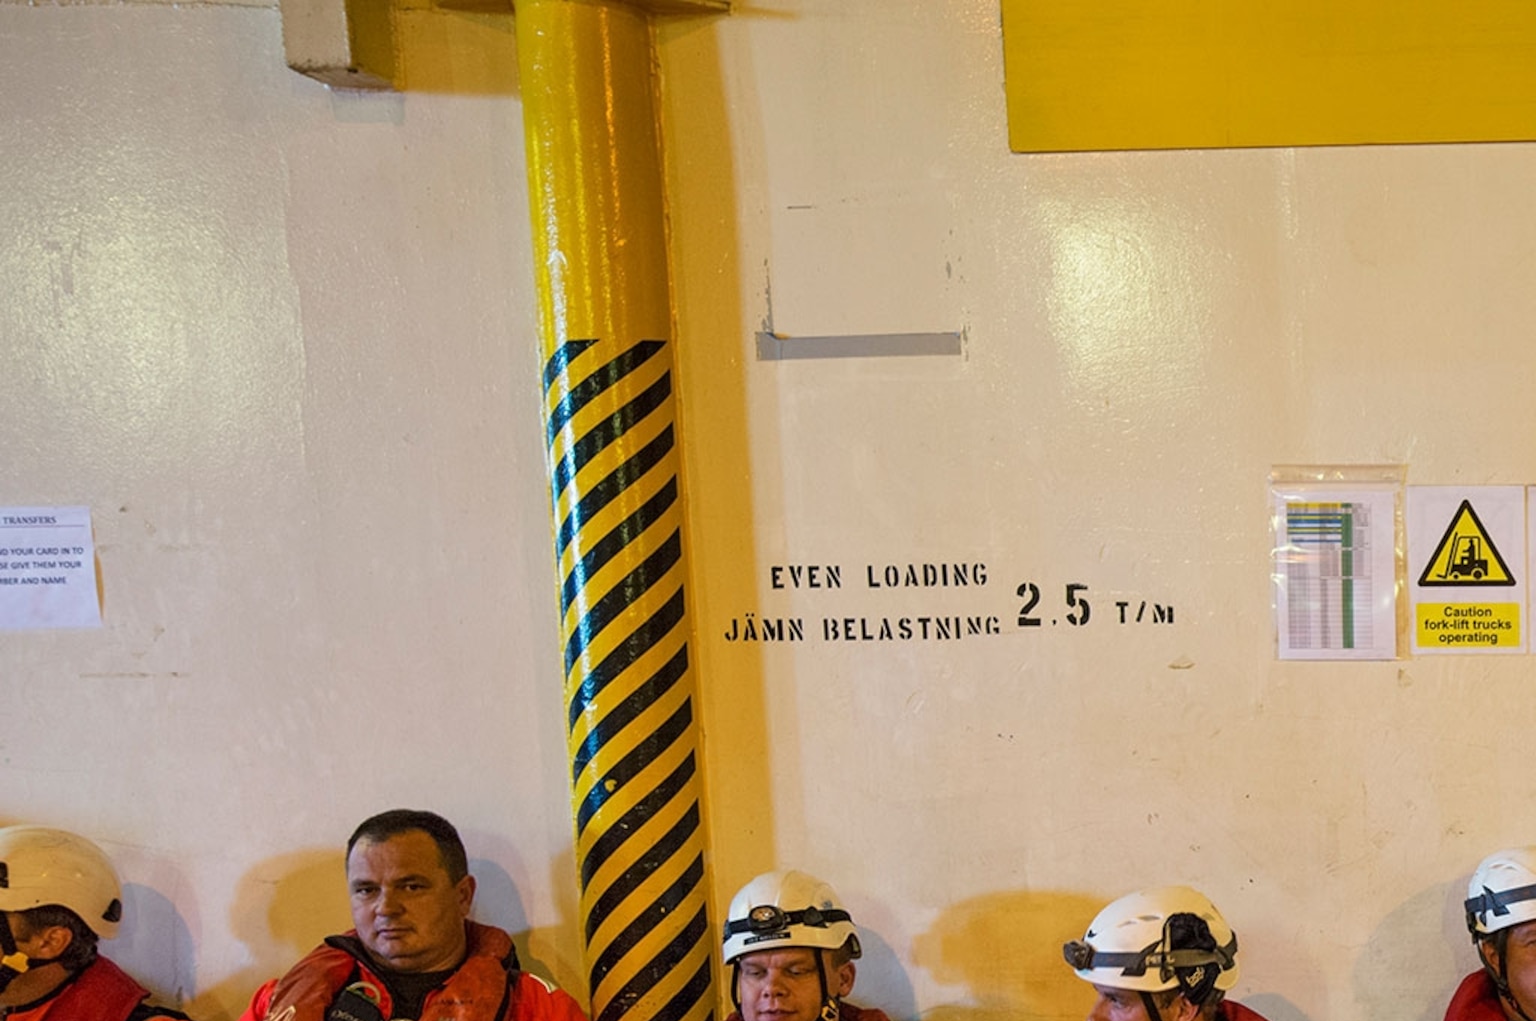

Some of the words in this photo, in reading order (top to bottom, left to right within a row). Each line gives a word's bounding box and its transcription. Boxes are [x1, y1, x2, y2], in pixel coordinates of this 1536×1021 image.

[11, 548, 34, 556] YOUR
[35, 548, 59, 556] CARD
[33, 561, 56, 569] THEM
[20, 577, 39, 585] AND
[771, 565, 842, 590] EVEN
[867, 562, 989, 589] LOADING
[1016, 582, 1091, 627] 2.5
[1115, 600, 1175, 625] T/M
[1444, 606, 1492, 618] Caution
[724, 612, 805, 642] JÄMN
[823, 615, 1001, 642] BELASTNING
[1424, 619, 1471, 630] fork-lift
[1473, 619, 1512, 630] trucks
[1438, 631, 1498, 645] operating
